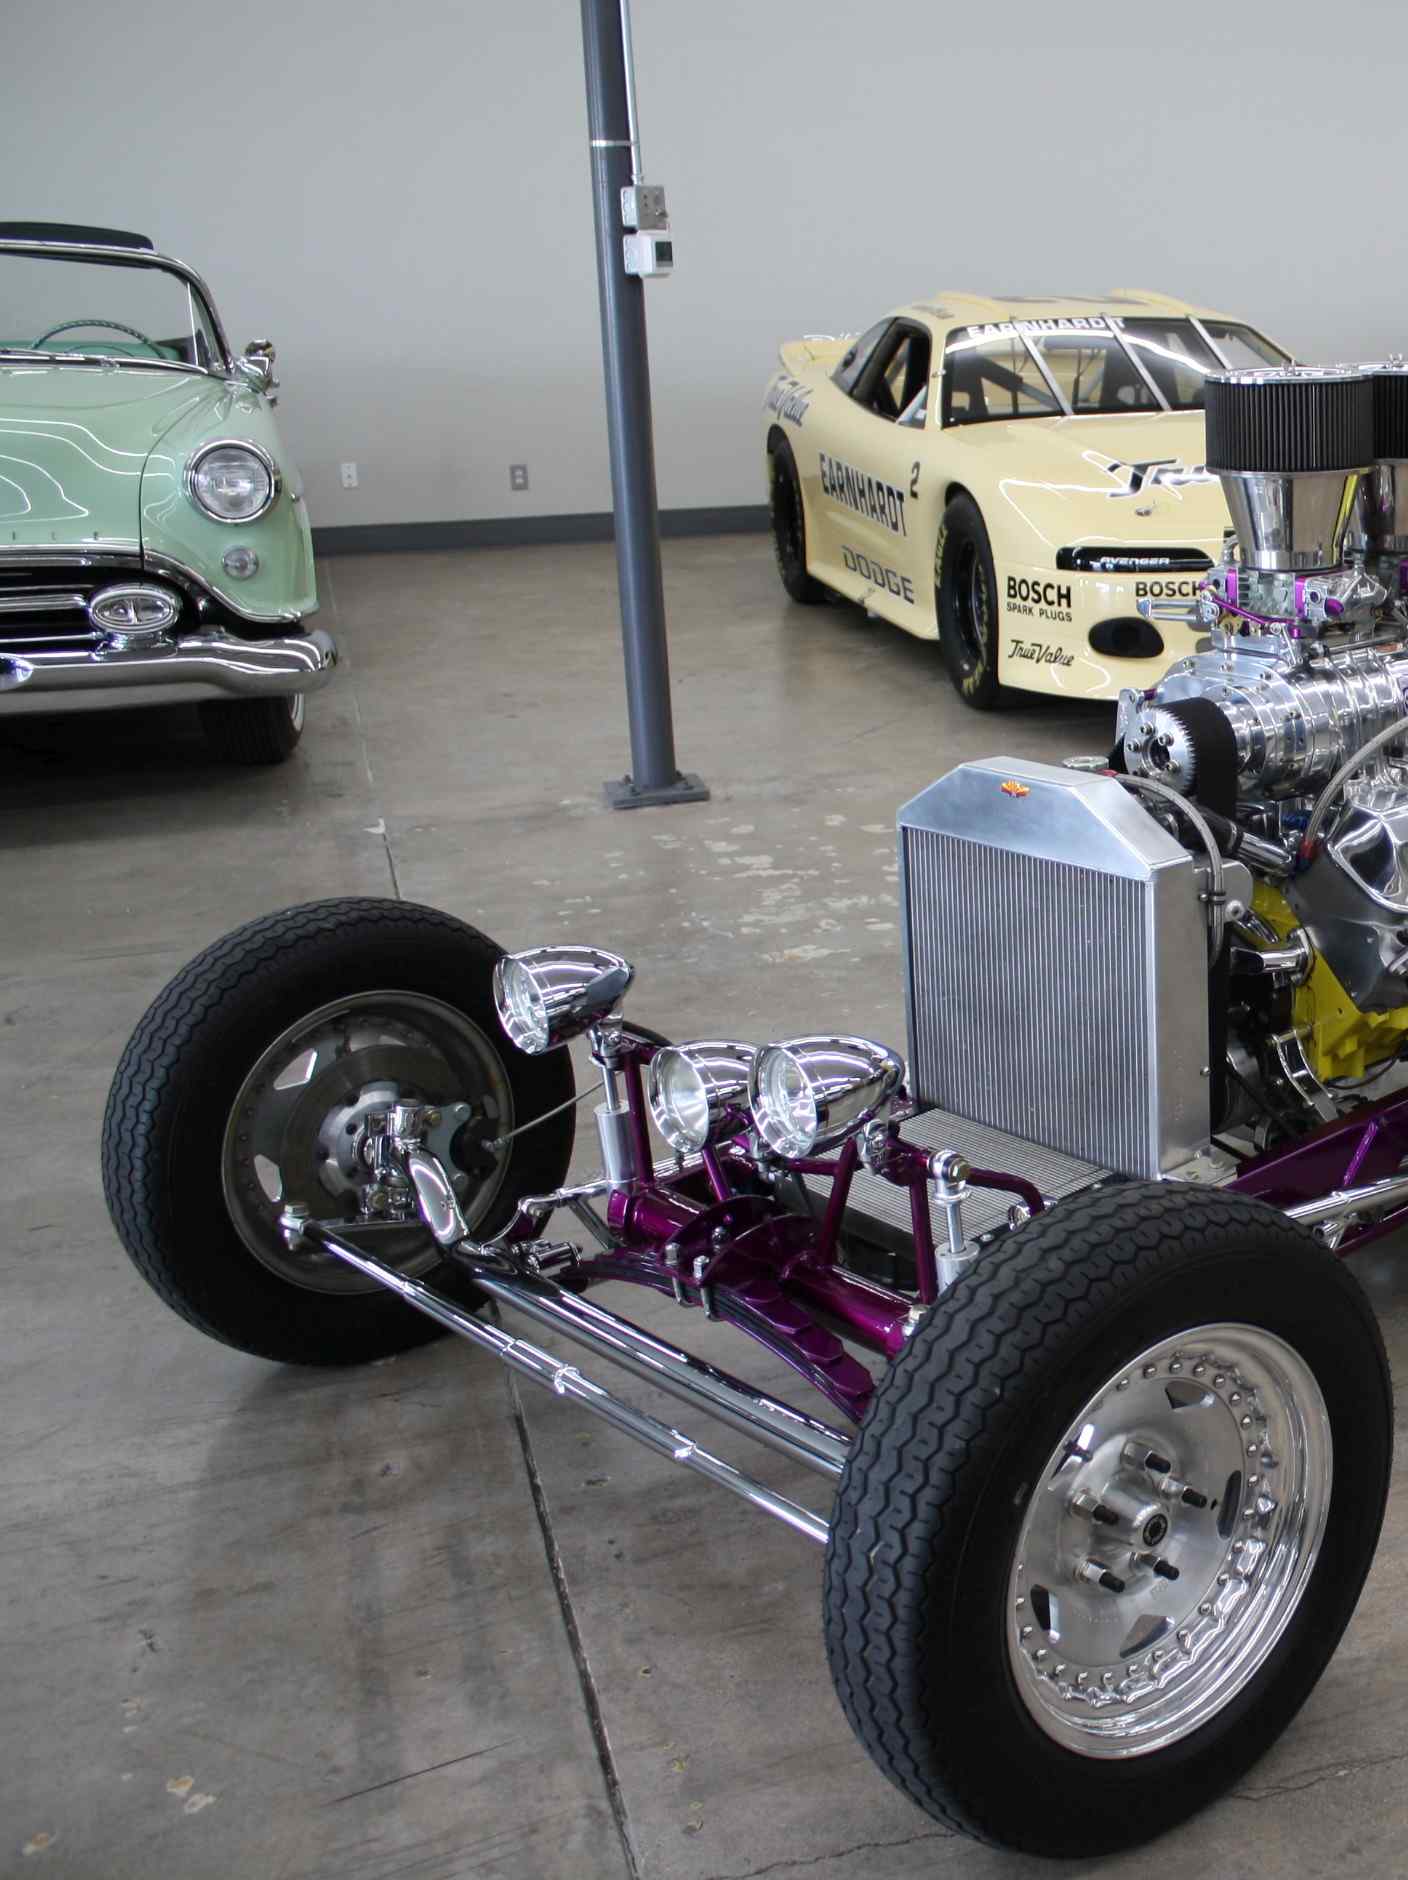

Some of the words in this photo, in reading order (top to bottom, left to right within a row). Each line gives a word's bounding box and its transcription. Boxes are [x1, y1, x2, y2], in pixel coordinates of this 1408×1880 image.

[819, 452, 907, 537] EARNHARDT
[910, 461, 921, 499] 2
[842, 545, 915, 605] DODGE
[1007, 576, 1072, 608] BOSCH
[1006, 602, 1034, 617] SPARK
[1039, 607, 1073, 623] PLUGS
